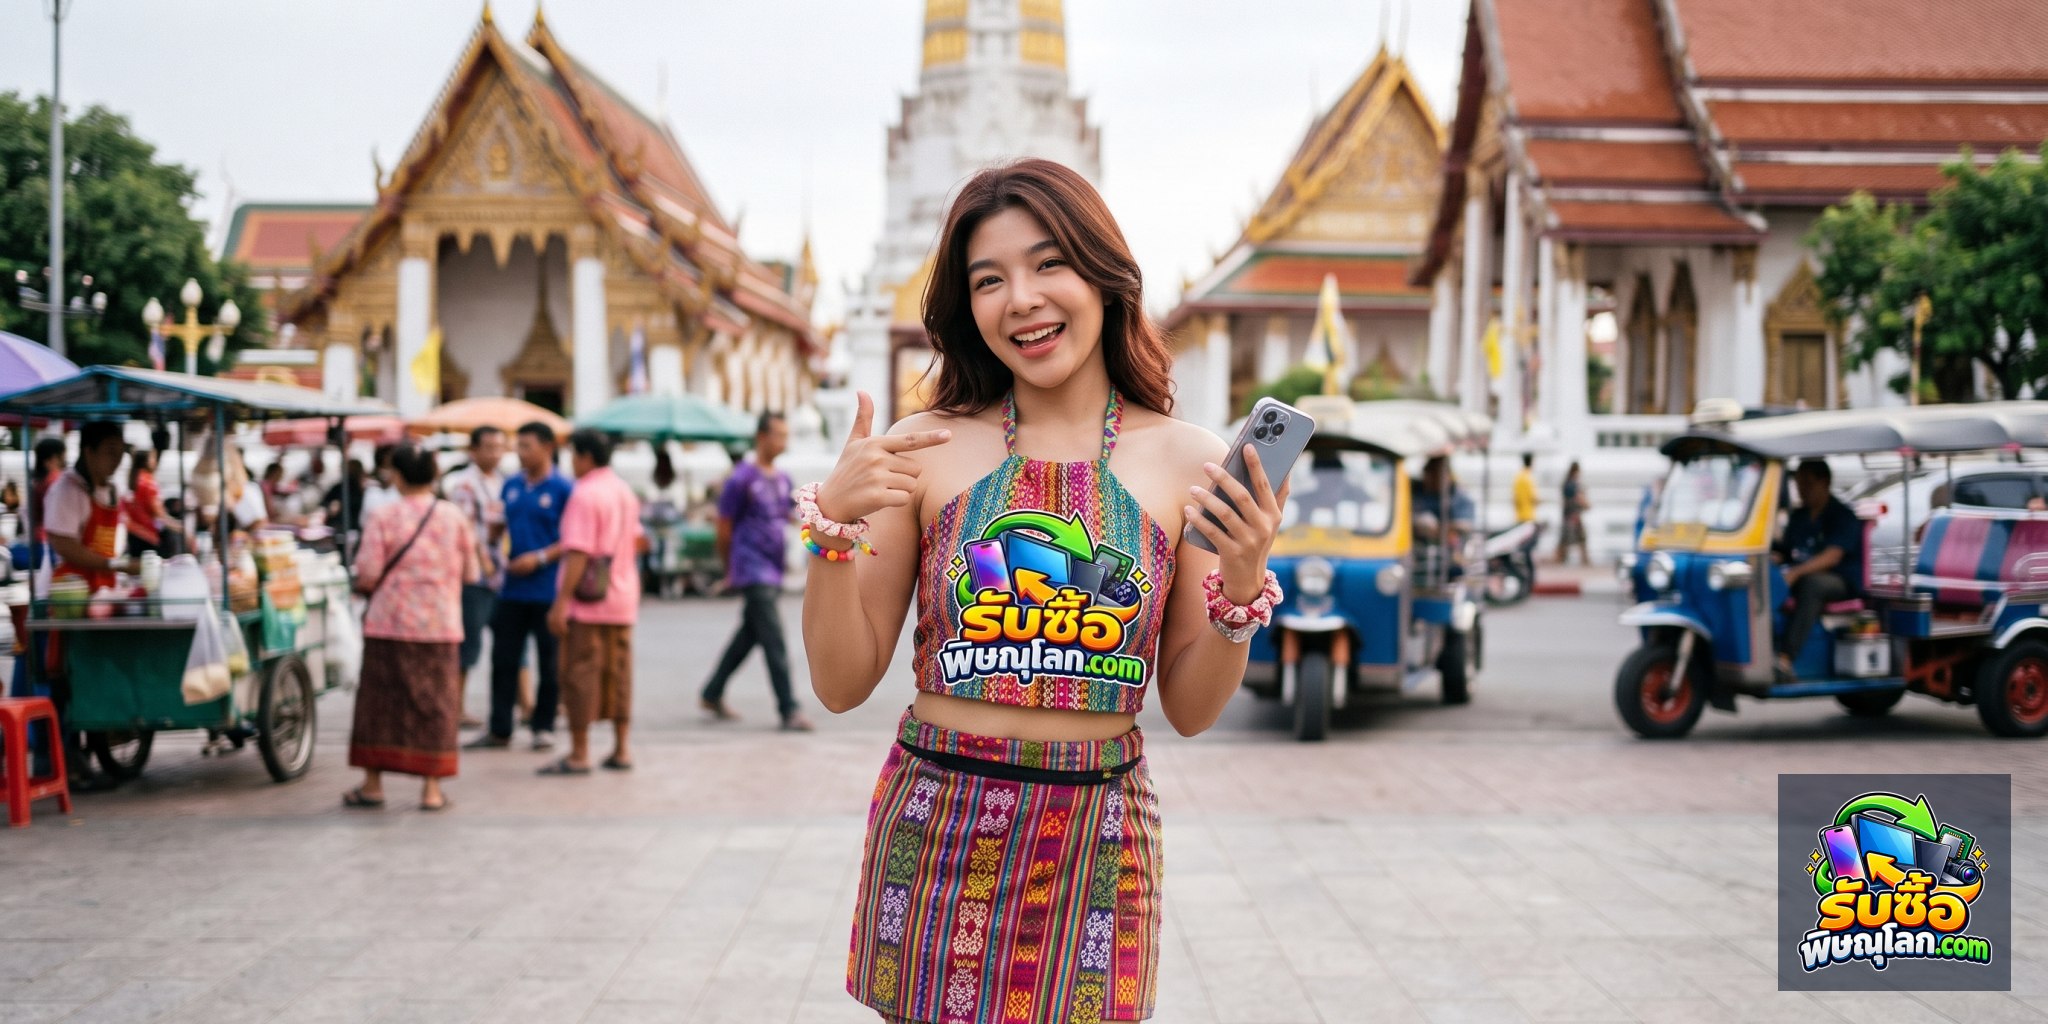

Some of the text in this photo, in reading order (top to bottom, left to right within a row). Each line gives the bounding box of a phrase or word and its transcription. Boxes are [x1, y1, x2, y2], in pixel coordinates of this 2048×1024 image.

[961, 588, 1122, 652] รับซื้อ
[942, 639, 1142, 680] พิษณุโลก.com
